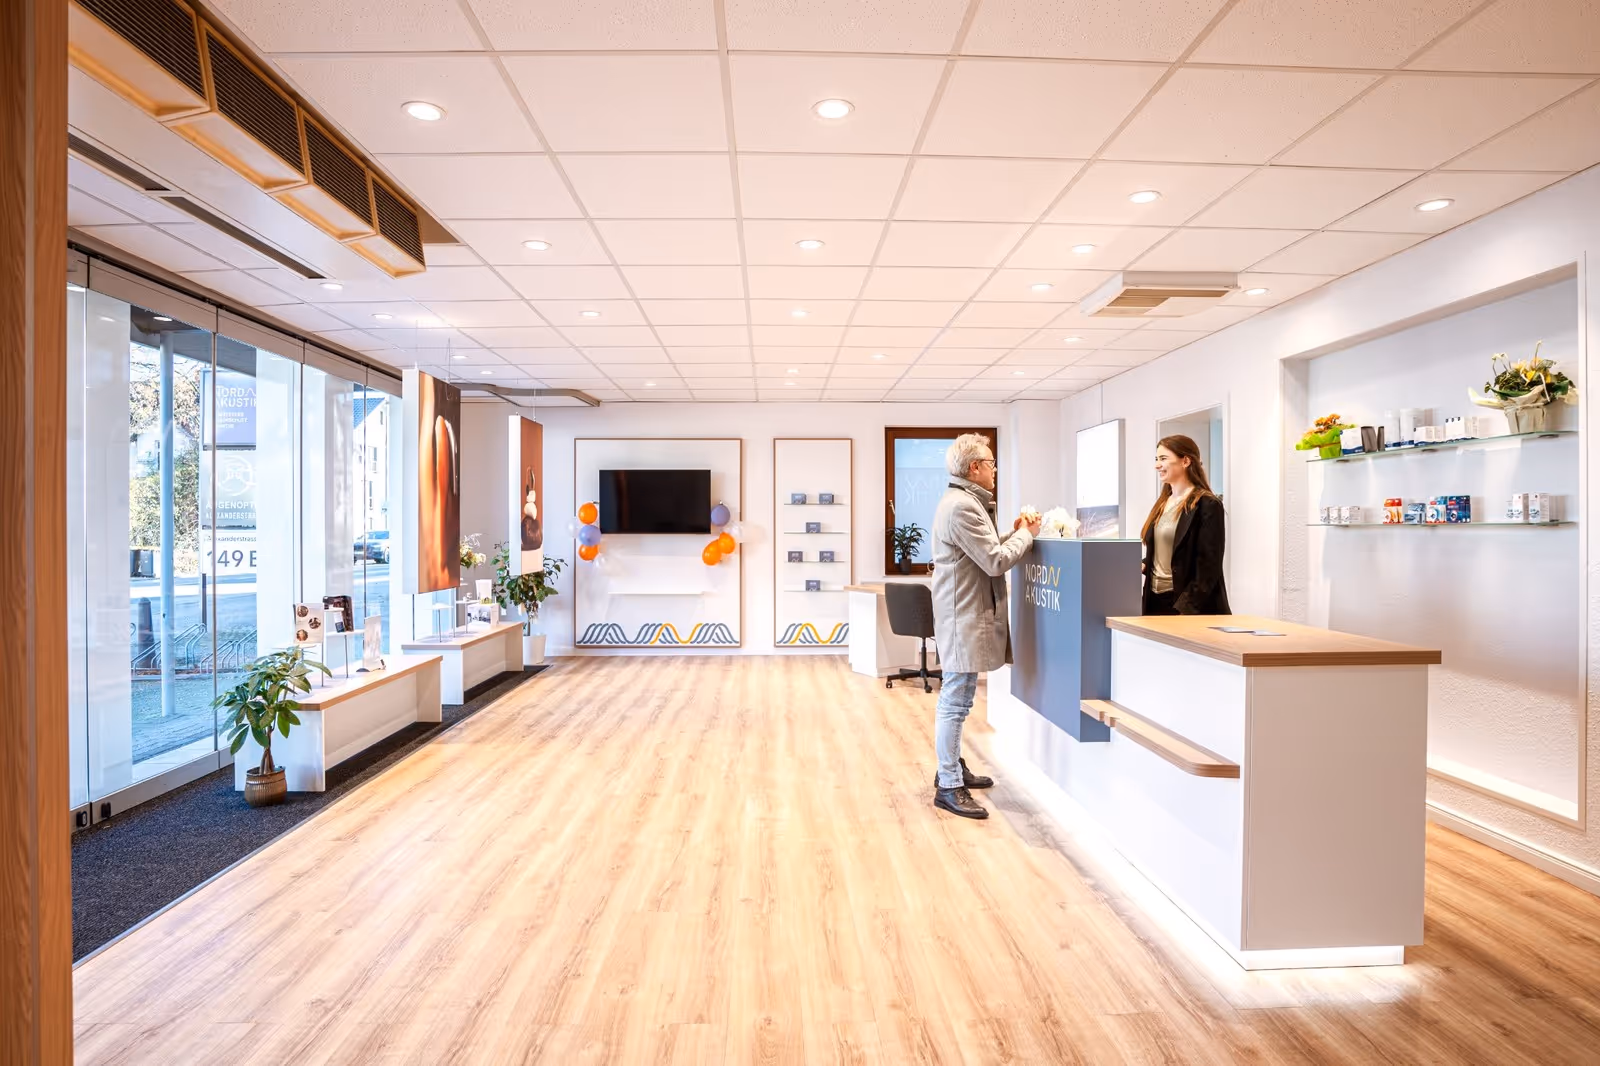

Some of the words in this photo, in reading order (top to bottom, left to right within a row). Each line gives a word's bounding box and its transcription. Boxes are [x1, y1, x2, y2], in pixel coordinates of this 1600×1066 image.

[206, 501, 256, 509] AGENOPT
[1025, 563, 1048, 584] NORD
[1025, 585, 1061, 611] AKUSTIK
